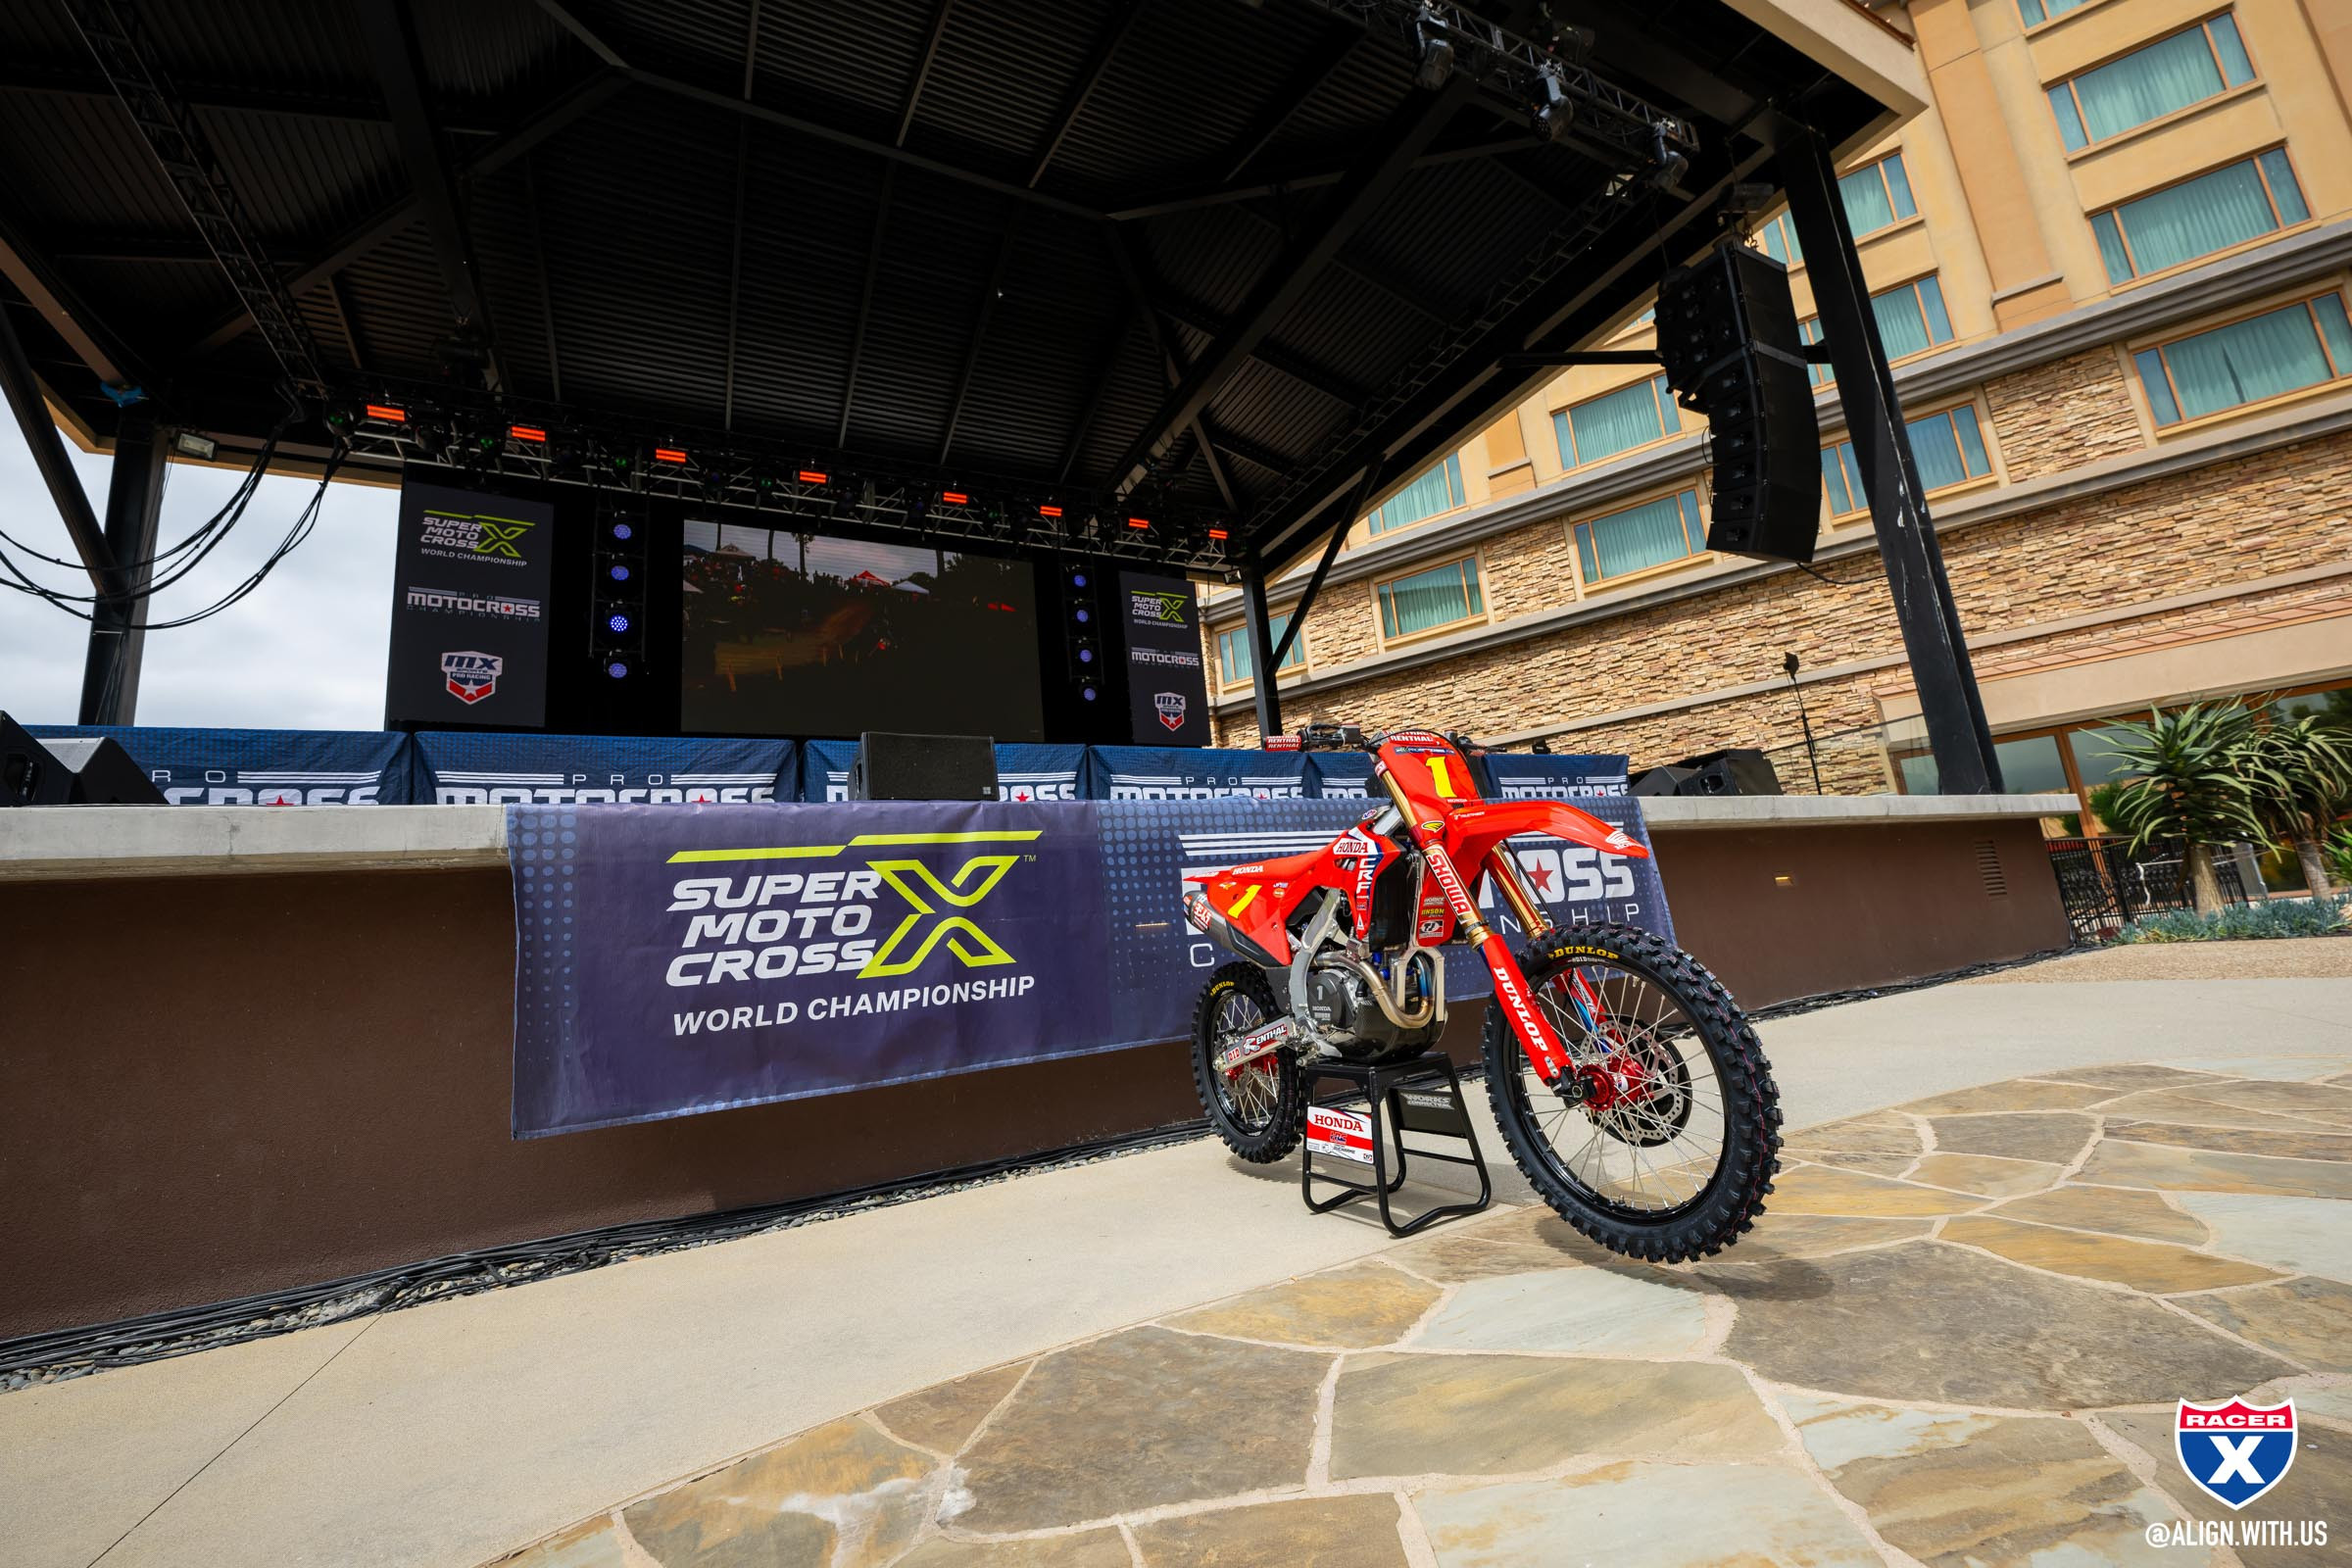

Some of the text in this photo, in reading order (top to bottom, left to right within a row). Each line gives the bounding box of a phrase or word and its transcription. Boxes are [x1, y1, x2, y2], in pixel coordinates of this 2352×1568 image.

[422, 516, 482, 532] SUPER
[425, 525, 479, 540] MOTO
[420, 534, 479, 550] CROSS
[421, 548, 527, 567] WORLD CHAMPIONSHIP
[407, 592, 541, 617] MOTOCROSS
[1132, 595, 1162, 605] SUPER
[1134, 602, 1161, 612] MOTO
[1132, 609, 1162, 618] CROSS
[1132, 652, 1200, 666] MOTOCROSS
[152, 769, 226, 783] RO
[572, 773, 663, 785] PRO
[1186, 776, 1238, 785] PRO
[1426, 757, 1457, 798] 1
[1547, 776, 1584, 785] PRO
[1336, 842, 1369, 854] HONDA
[1232, 865, 1264, 875] HONDA
[1355, 858, 1377, 895] CRF
[666, 869, 882, 912] SUPER
[1425, 853, 1471, 916] SHOWA
[1227, 884, 1262, 919] 1
[681, 904, 873, 949] MOTO
[1553, 946, 1619, 959] DUNLOP
[665, 938, 877, 987] CROSS
[1211, 980, 1235, 995] DUNLOP
[1316, 985, 1324, 1001] 1
[673, 975, 1036, 1036] WORLD CHAMPIONSHIP
[1494, 966, 1548, 1052] DUNLOP
[1244, 1025, 1287, 1055] RENTHAL
[1405, 1094, 1451, 1102] WORKS
[1314, 1114, 1364, 1132] HONDA
